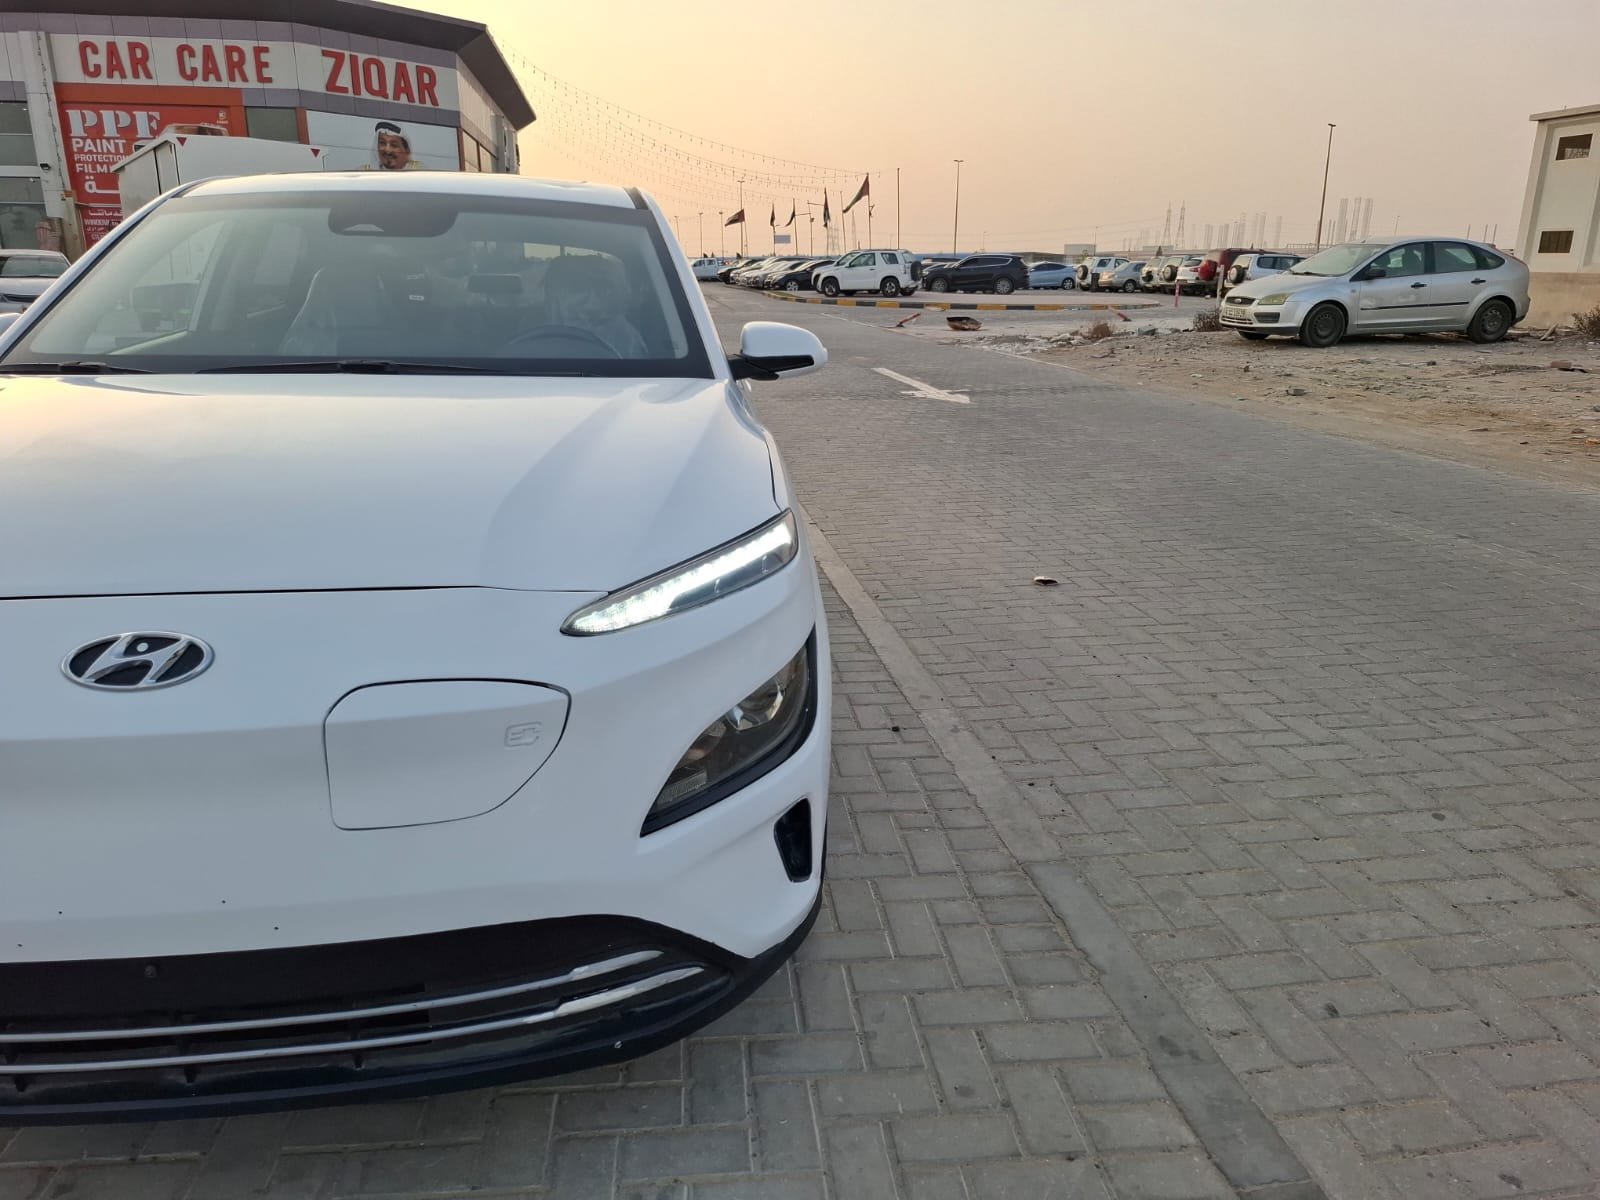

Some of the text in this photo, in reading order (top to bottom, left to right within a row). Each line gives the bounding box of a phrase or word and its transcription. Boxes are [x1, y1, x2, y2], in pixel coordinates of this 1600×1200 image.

[78, 40, 440, 107] CAR CARE ZIQAR
[65, 109, 160, 138] PPF
[71, 138, 127, 153] PAINT
